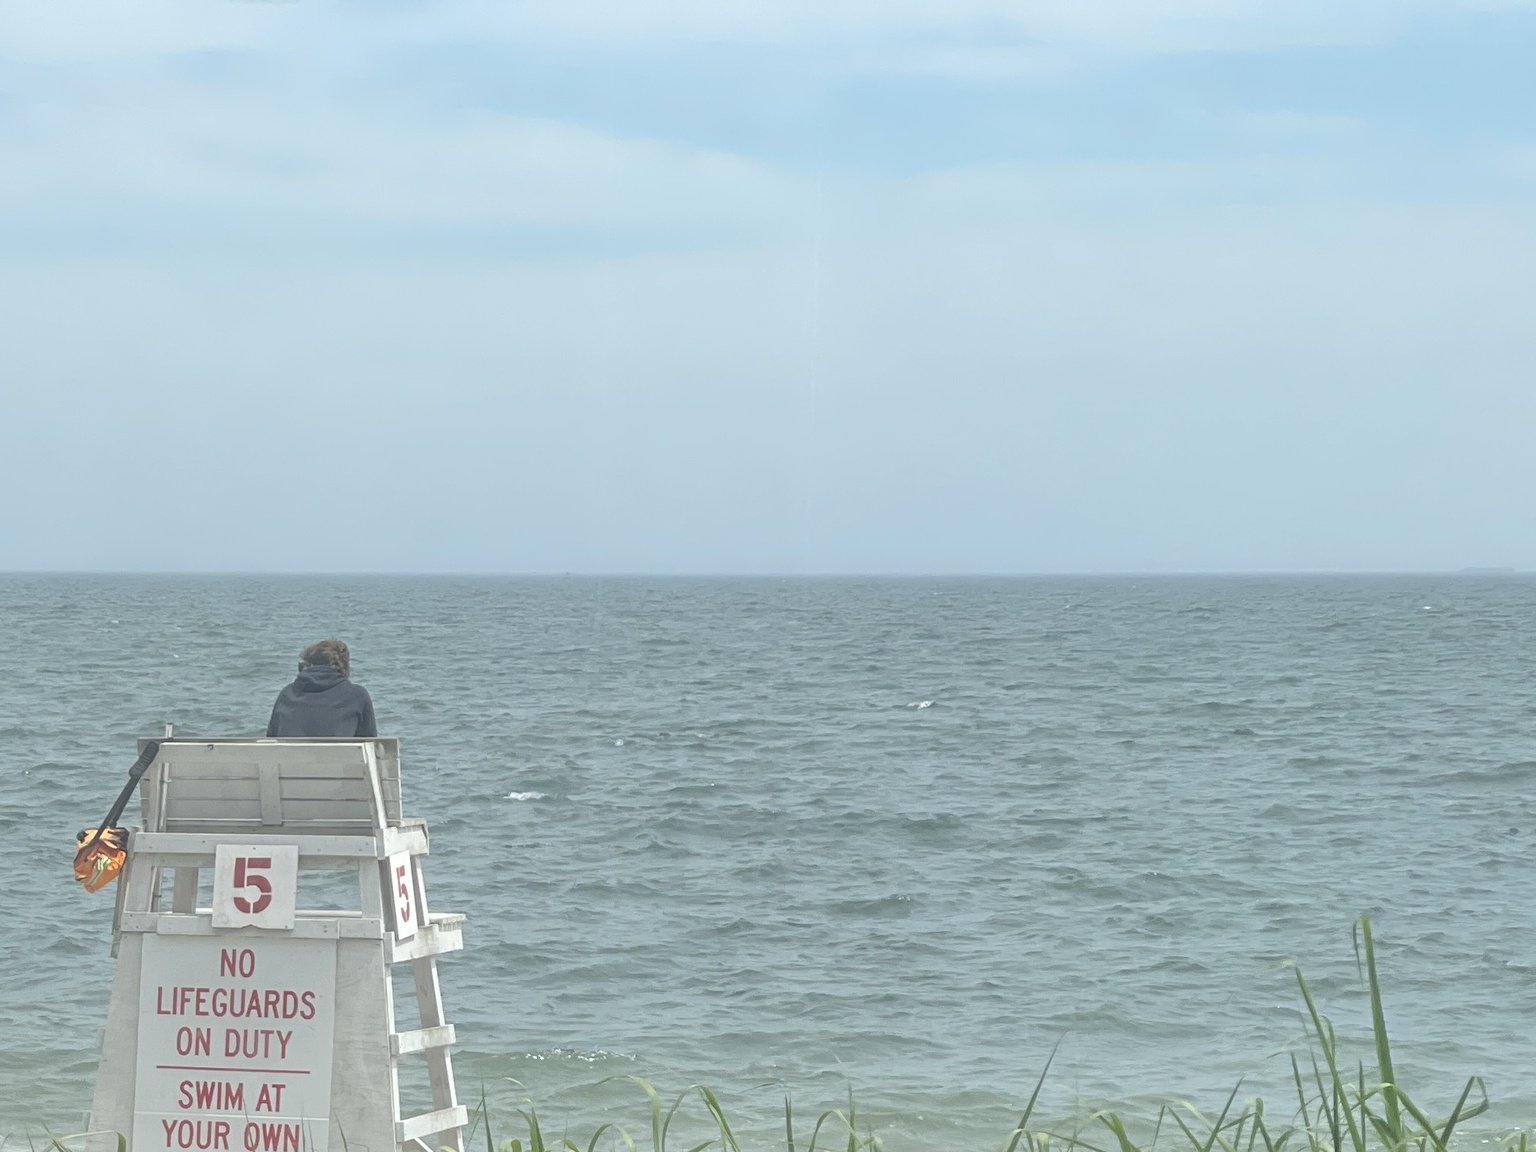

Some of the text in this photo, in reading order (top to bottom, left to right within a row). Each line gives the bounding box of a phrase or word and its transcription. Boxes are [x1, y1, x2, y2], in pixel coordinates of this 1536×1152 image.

[232, 857, 272, 914] 5
[396, 864, 411, 922] 5
[220, 948, 256, 978] NO
[156, 986, 316, 1020] LIFEGUARDS
[176, 1027, 293, 1059] ON DUTY
[178, 1080, 286, 1112] SWIM AT
[162, 1119, 300, 1152] YOUR OWN
